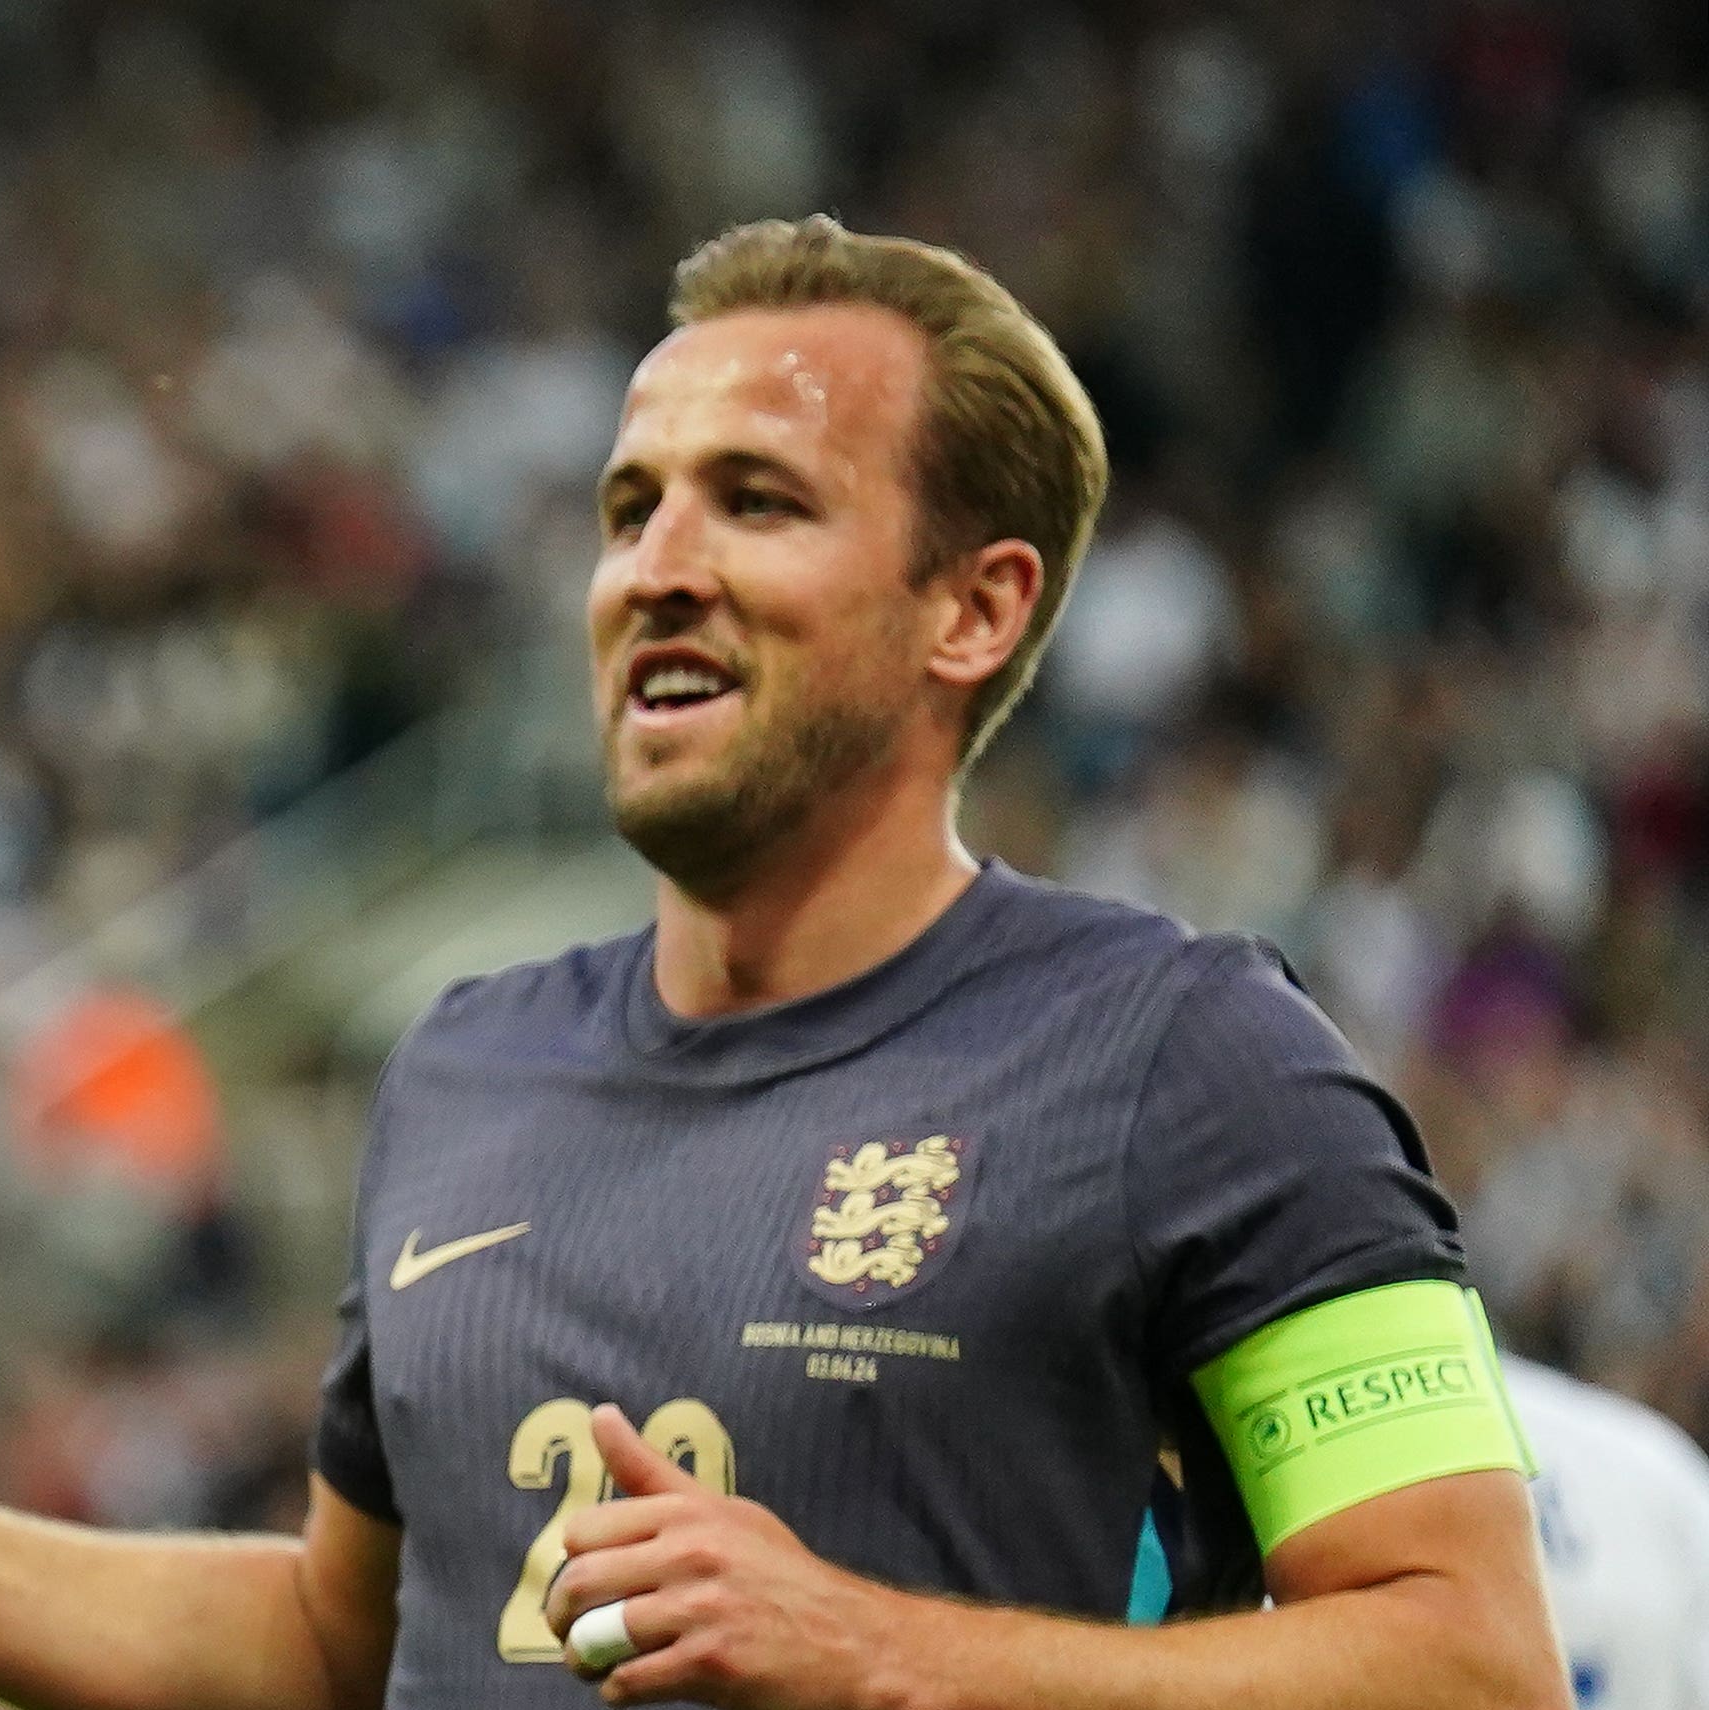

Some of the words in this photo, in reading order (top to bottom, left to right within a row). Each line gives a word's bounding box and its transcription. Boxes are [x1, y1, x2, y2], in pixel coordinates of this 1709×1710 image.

[742, 1321, 800, 1347] BOSNIA
[802, 1322, 839, 1349] AND
[839, 1324, 960, 1360] HERZEGOVINA
[1304, 1358, 1477, 1429] RESPECT
